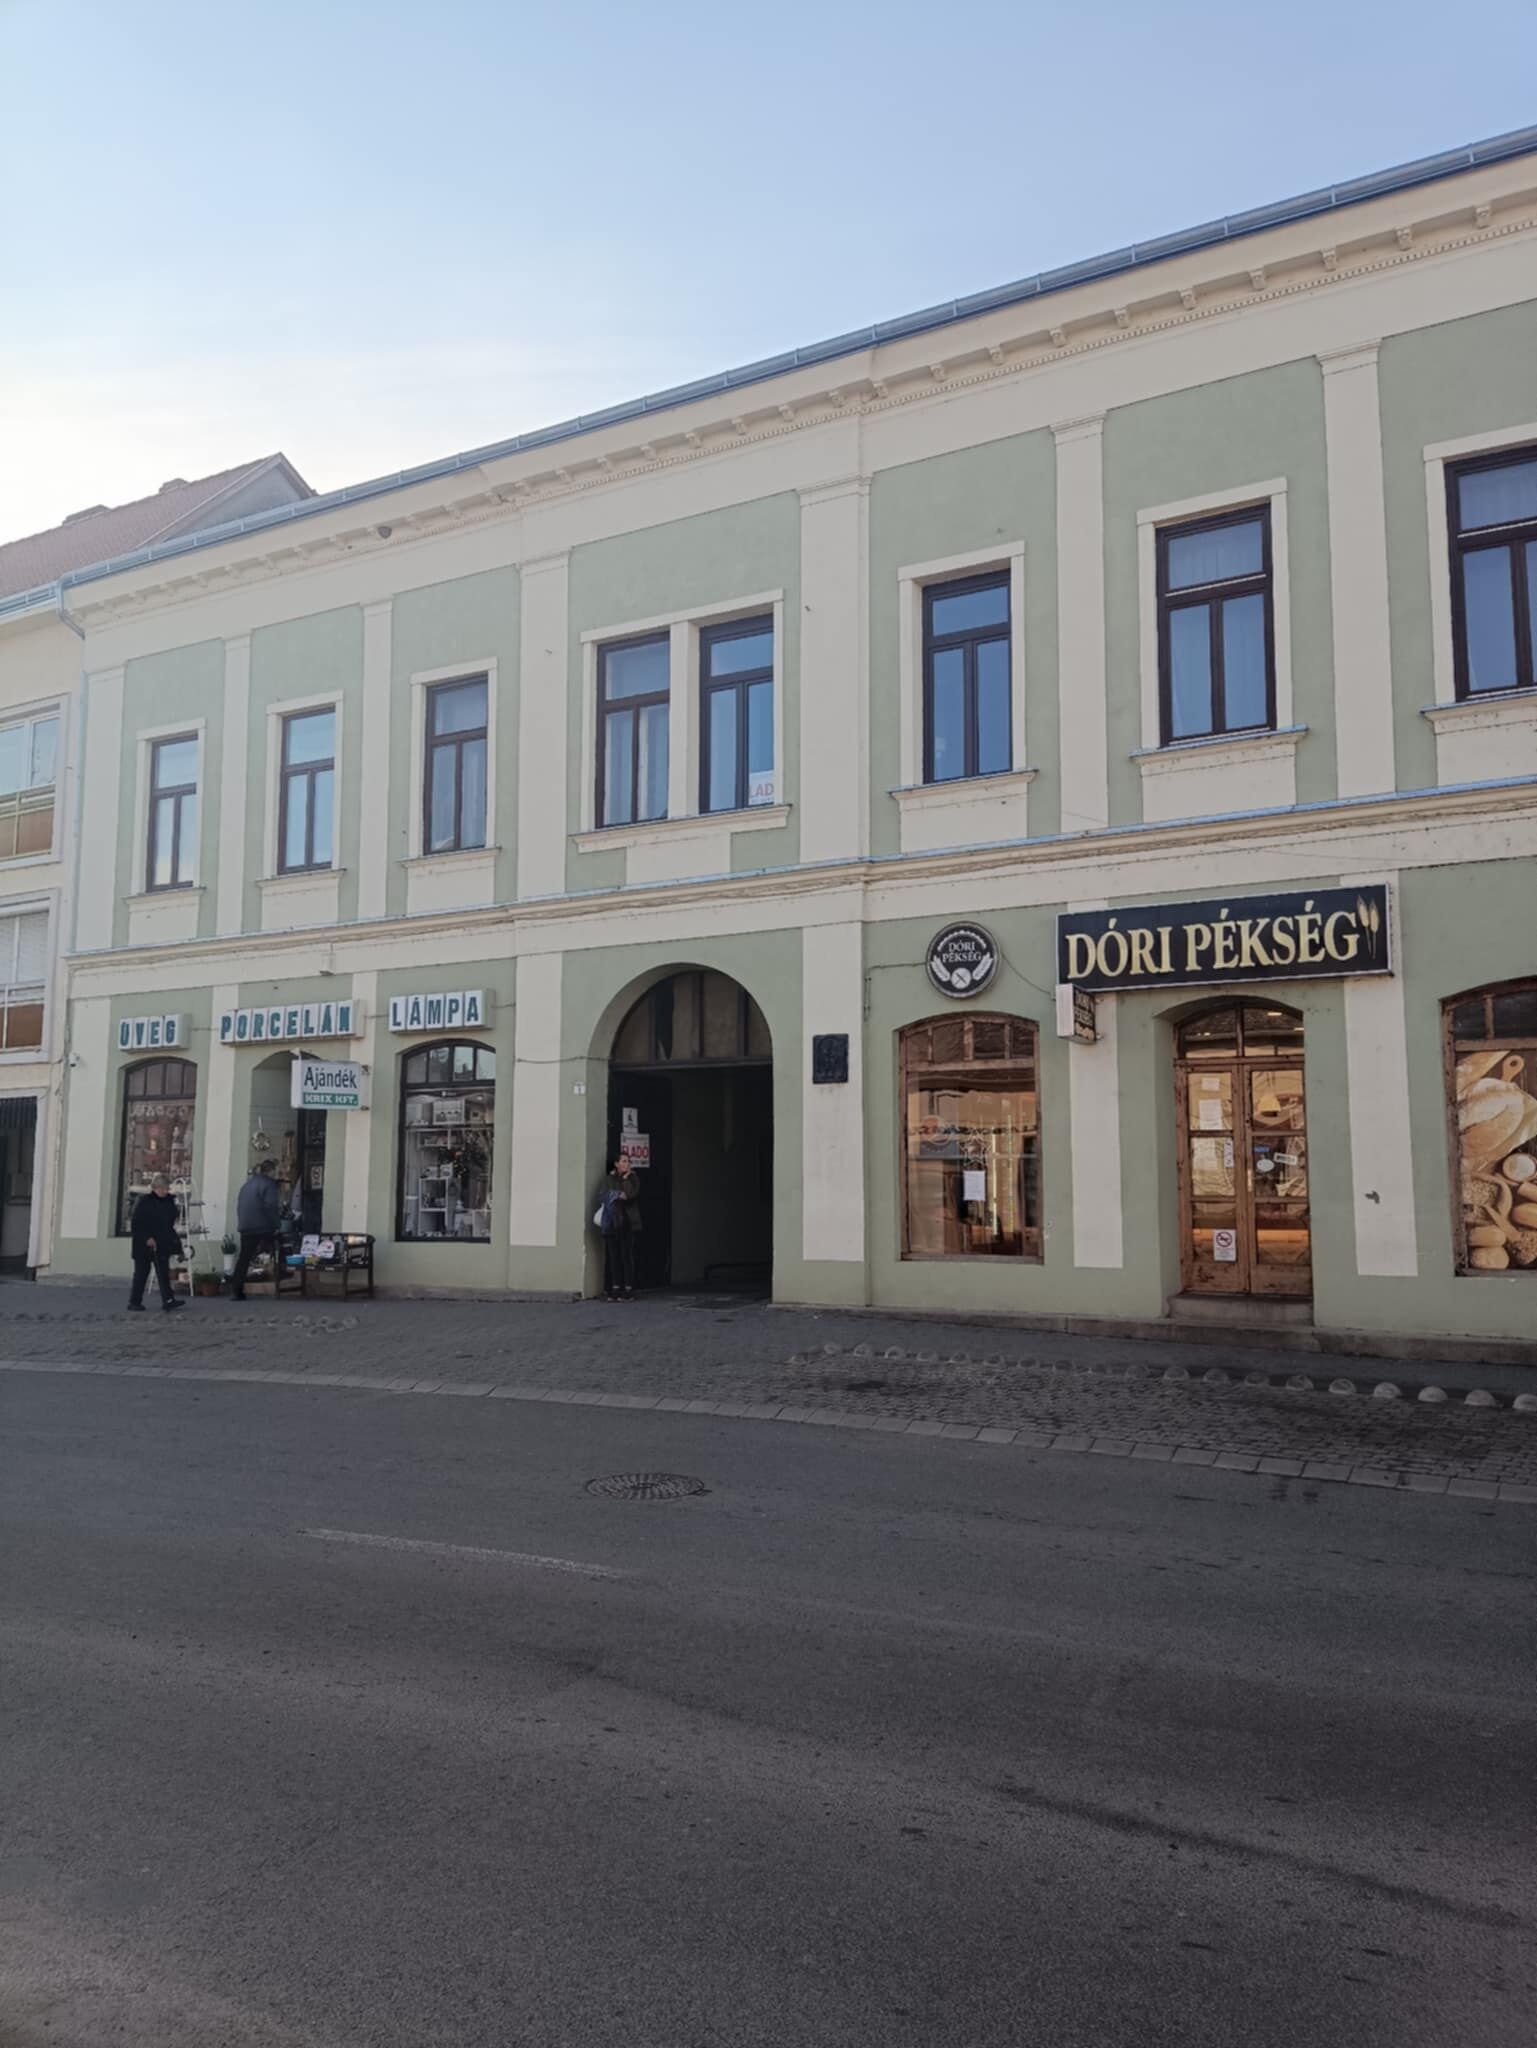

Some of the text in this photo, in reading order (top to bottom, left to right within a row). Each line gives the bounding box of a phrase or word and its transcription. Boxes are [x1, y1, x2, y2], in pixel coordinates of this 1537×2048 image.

[949, 940, 976, 951] DÓRI
[1065, 900, 1361, 980] DÓRI PÉKSÉG
[942, 951, 982, 963] PÉKSÉG
[220, 1004, 351, 1040] PORCELÁN
[391, 996, 479, 1027] LÁMPA
[303, 1066, 358, 1090] Ajándék
[304, 1094, 333, 1104] KRIX
